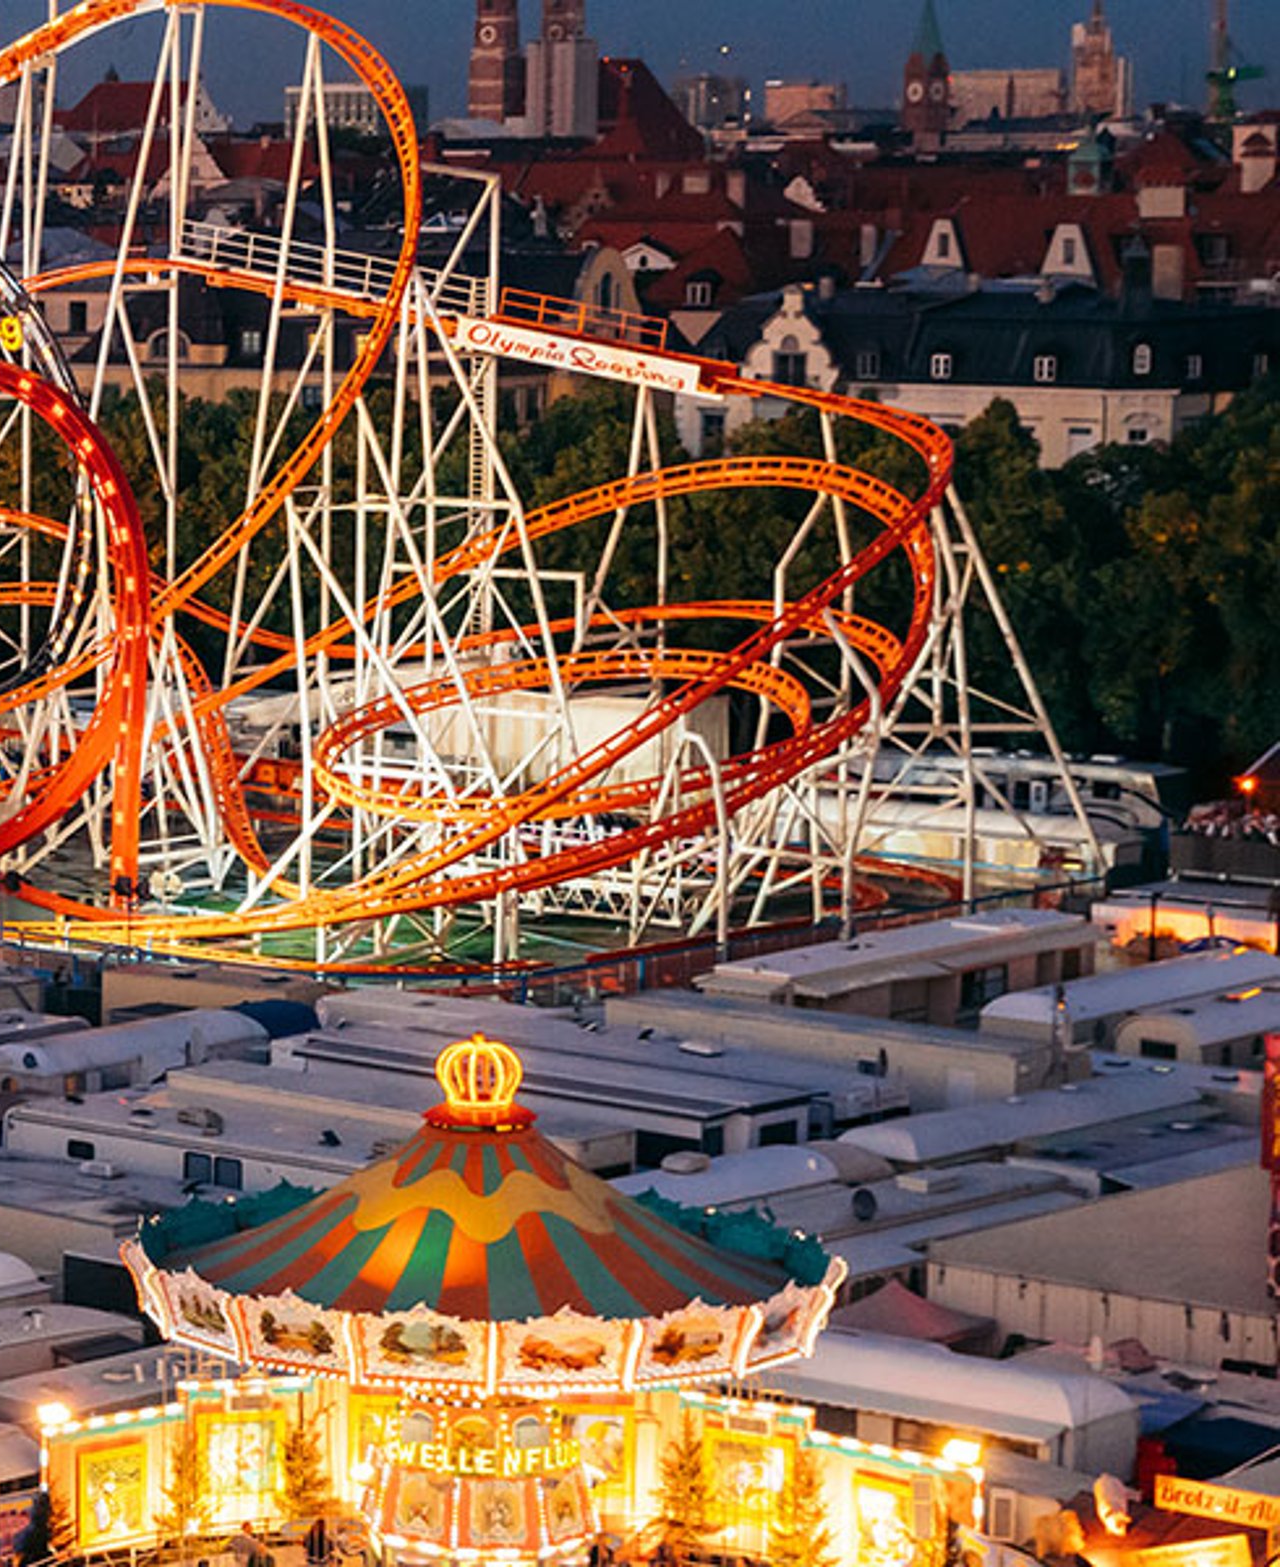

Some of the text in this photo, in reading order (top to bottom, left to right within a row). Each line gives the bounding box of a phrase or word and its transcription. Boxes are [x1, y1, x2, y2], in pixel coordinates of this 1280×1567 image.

[468, 322, 686, 391] Olympia Looping
[1161, 1486, 1280, 1521] Brotzit-Al
